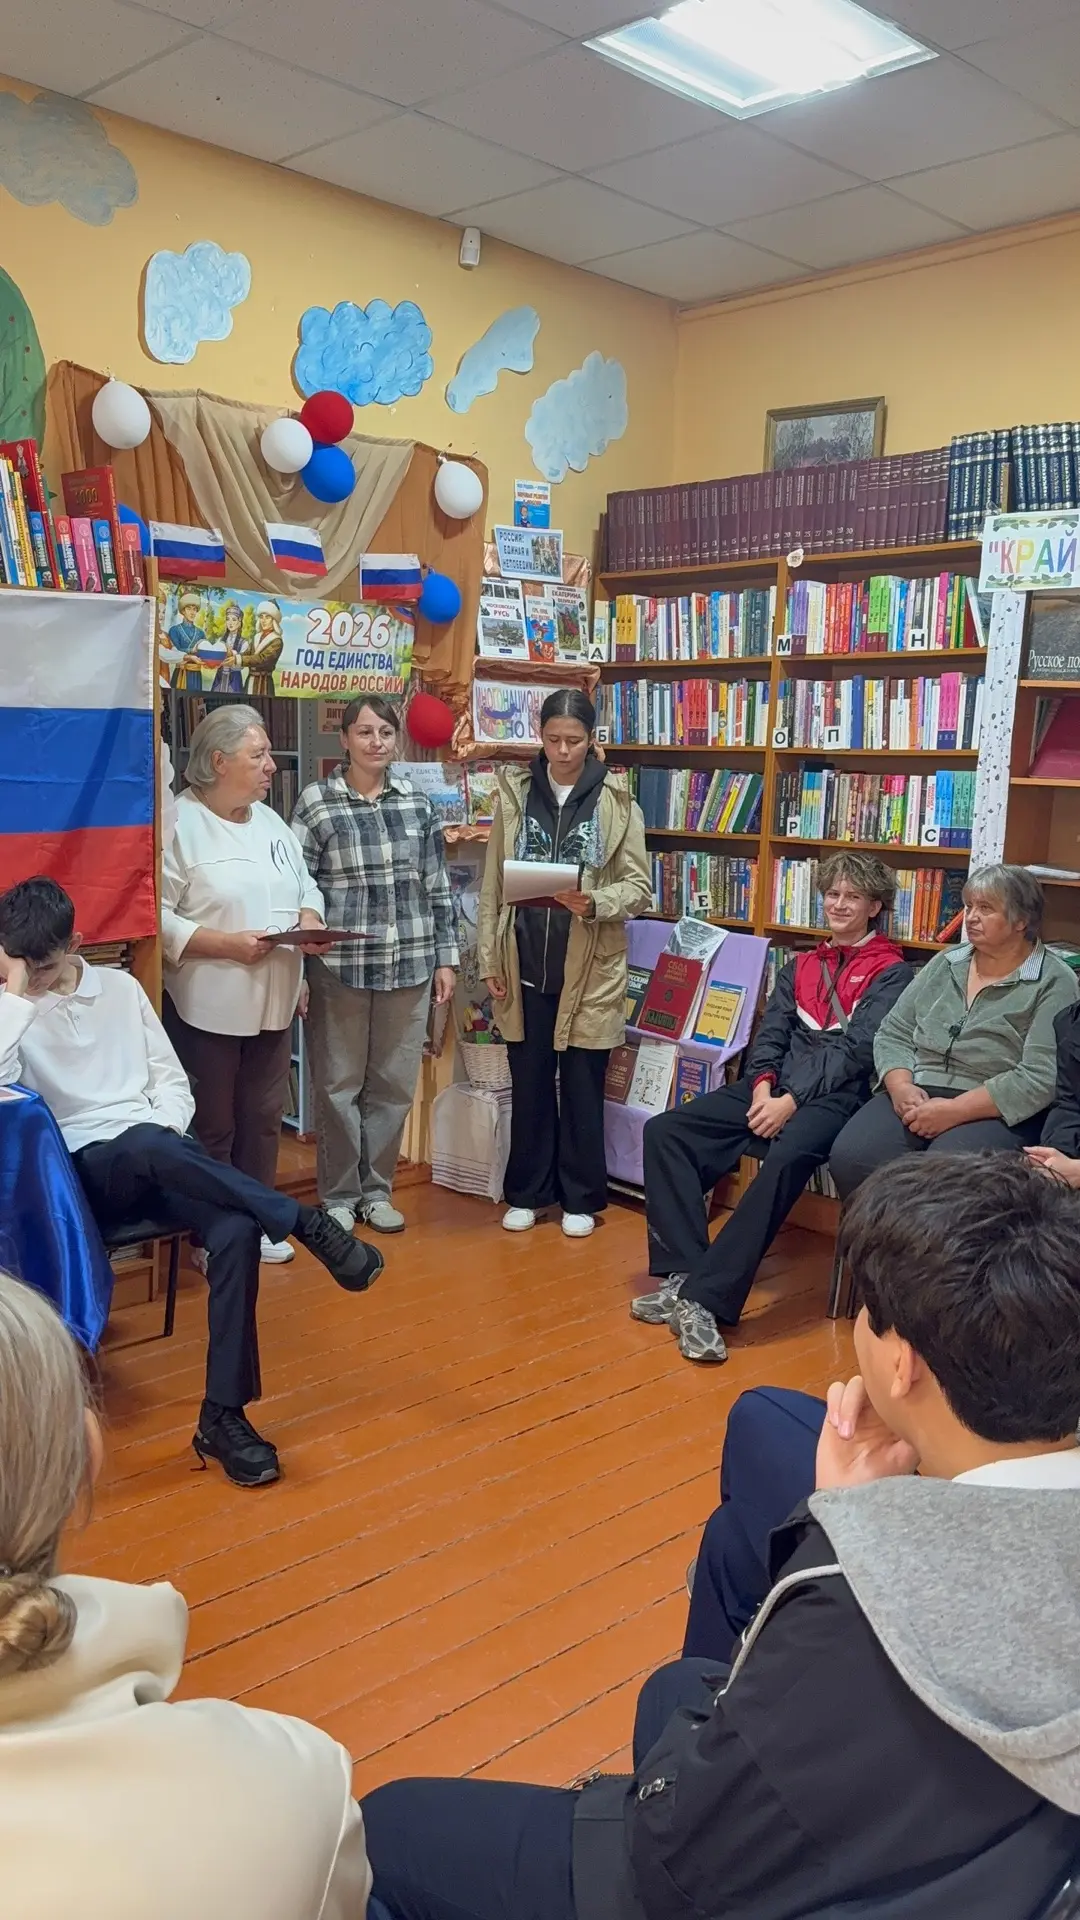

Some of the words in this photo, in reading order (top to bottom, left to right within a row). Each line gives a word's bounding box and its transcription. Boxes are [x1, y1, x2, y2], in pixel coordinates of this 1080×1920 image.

[503, 545, 525, 556] ЕДИНАЯ
[493, 609, 510, 618] РУСЬ
[306, 607, 392, 649] 2026
[777, 639, 791, 652] М
[911, 633, 925, 647] Н
[295, 648, 325, 670] ГОД
[328, 651, 393, 671] ЕДИНСТВА
[590, 647, 604, 660] А
[1028, 649, 1065, 672] Русское
[1067, 656, 1080, 668] по
[280, 671, 347, 693] НАРОДОВ
[350, 675, 404, 694] РОССИИ
[598, 730, 607, 742] Б
[775, 731, 786, 744] О
[828, 729, 839, 742] П
[789, 821, 798, 834] Р
[924, 829, 937, 842] С
[697, 895, 709, 908] Е
